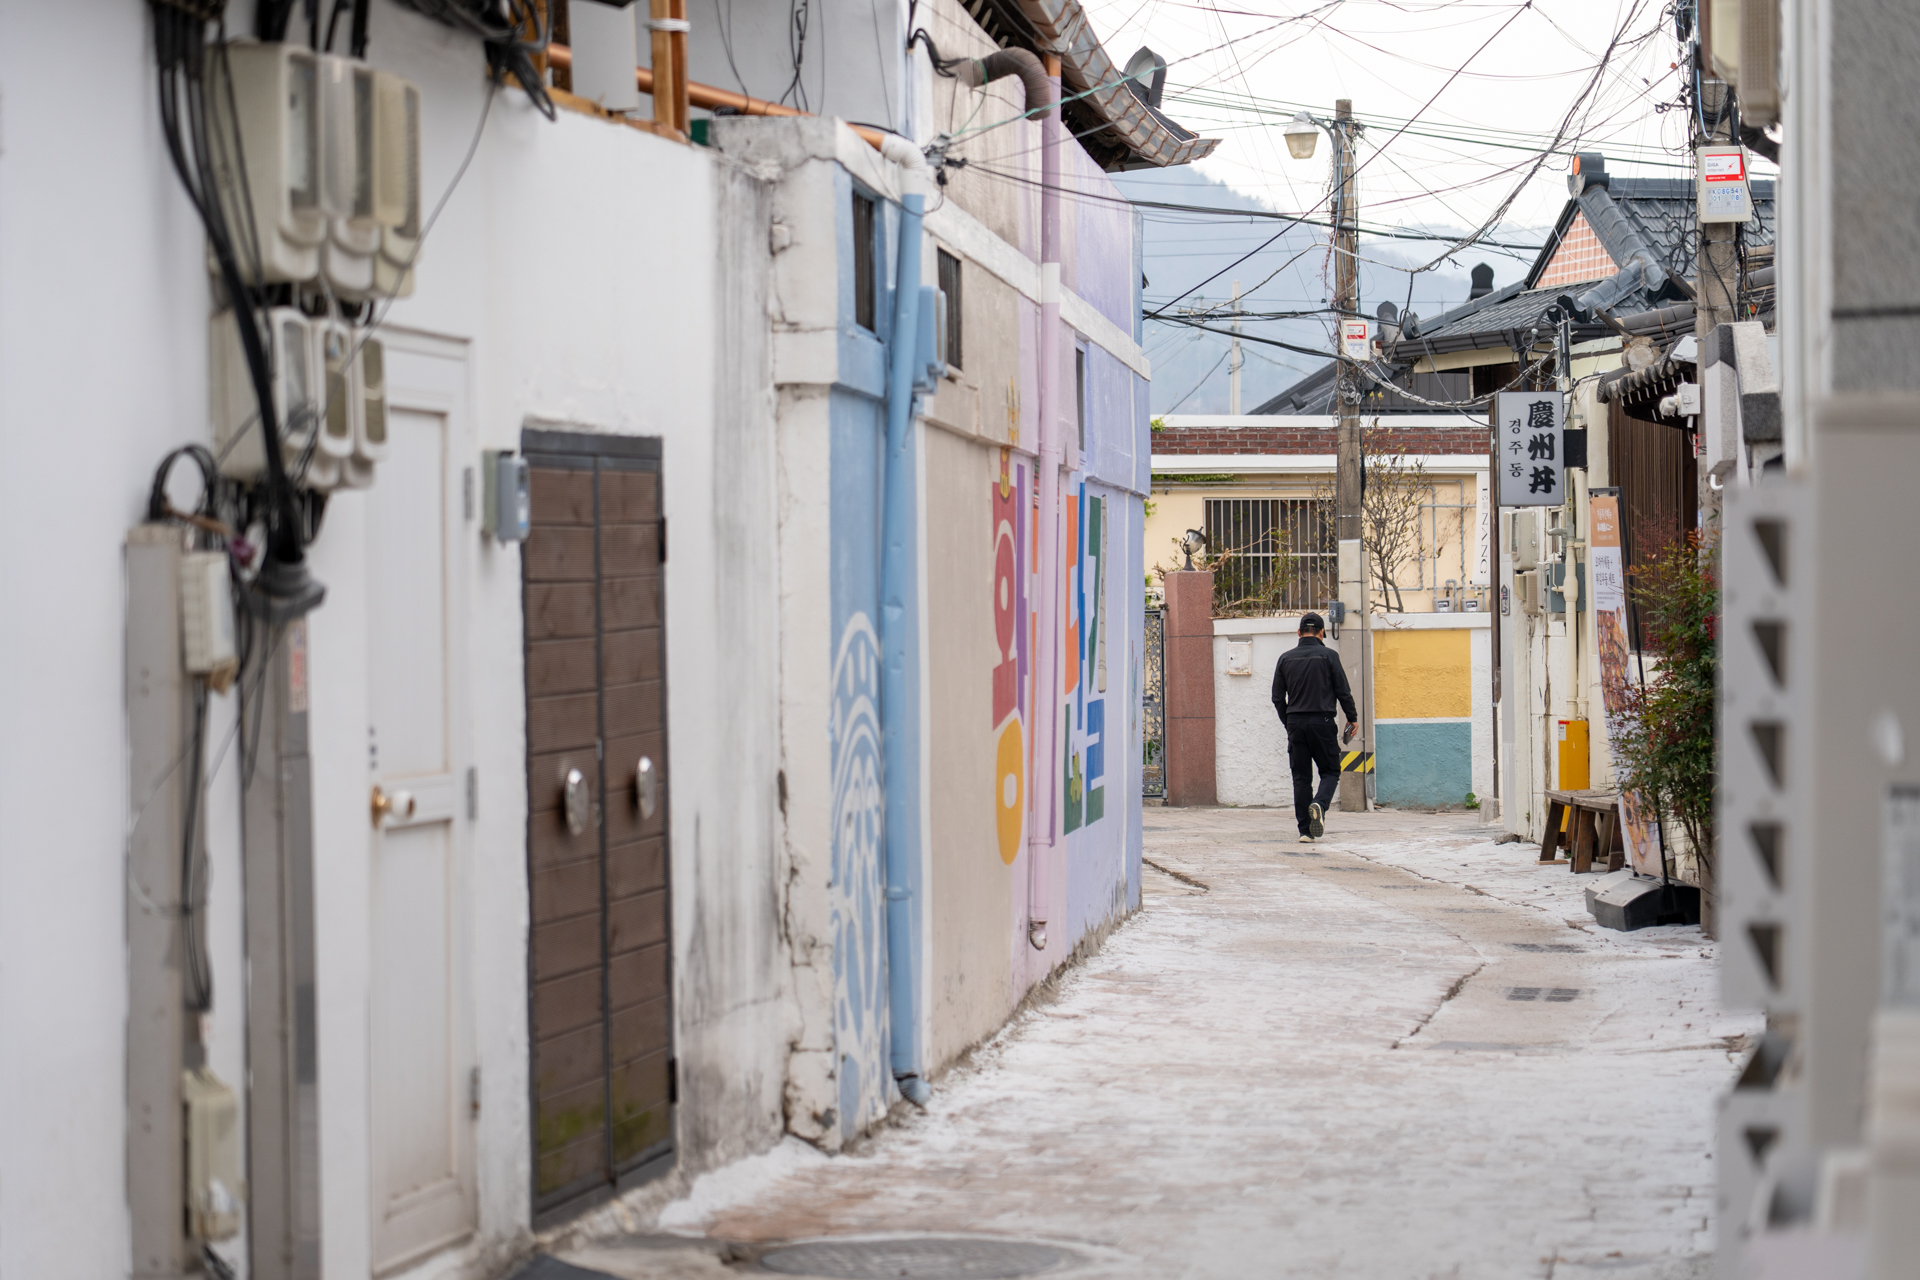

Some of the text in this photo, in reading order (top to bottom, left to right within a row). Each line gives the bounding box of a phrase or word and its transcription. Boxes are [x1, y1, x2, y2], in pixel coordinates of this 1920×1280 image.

[1508, 418, 1524, 478] 경주동
[1527, 400, 1556, 494] 慶州丼
